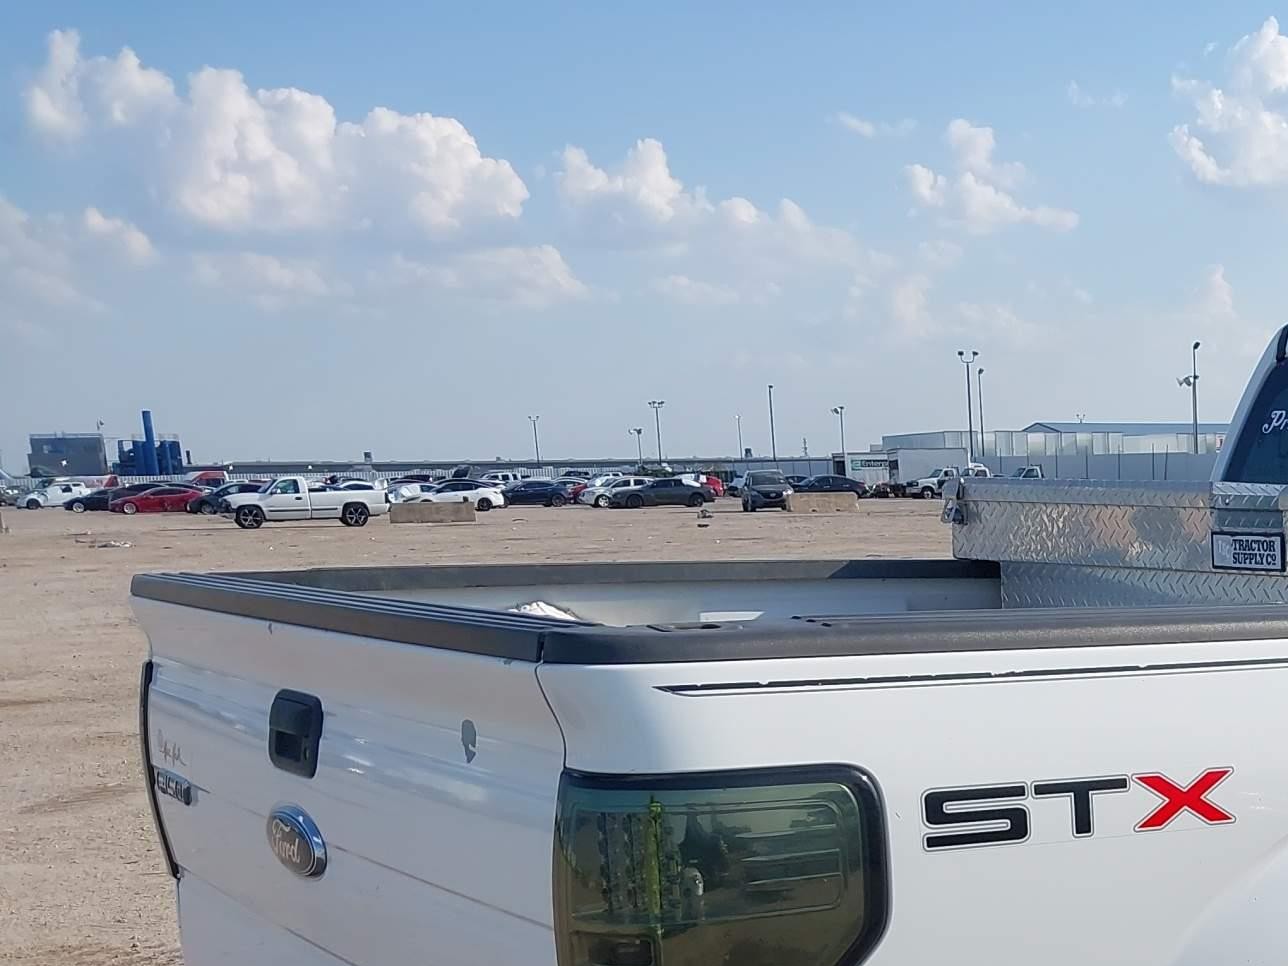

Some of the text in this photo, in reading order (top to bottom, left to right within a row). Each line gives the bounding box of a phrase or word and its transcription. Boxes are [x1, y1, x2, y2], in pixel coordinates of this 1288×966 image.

[1231, 538, 1276, 552] TRACTOR
[1232, 552, 1264, 565] SUPPLY
[921, 767, 1236, 852] STX
[272, 819, 301, 863] Ford
